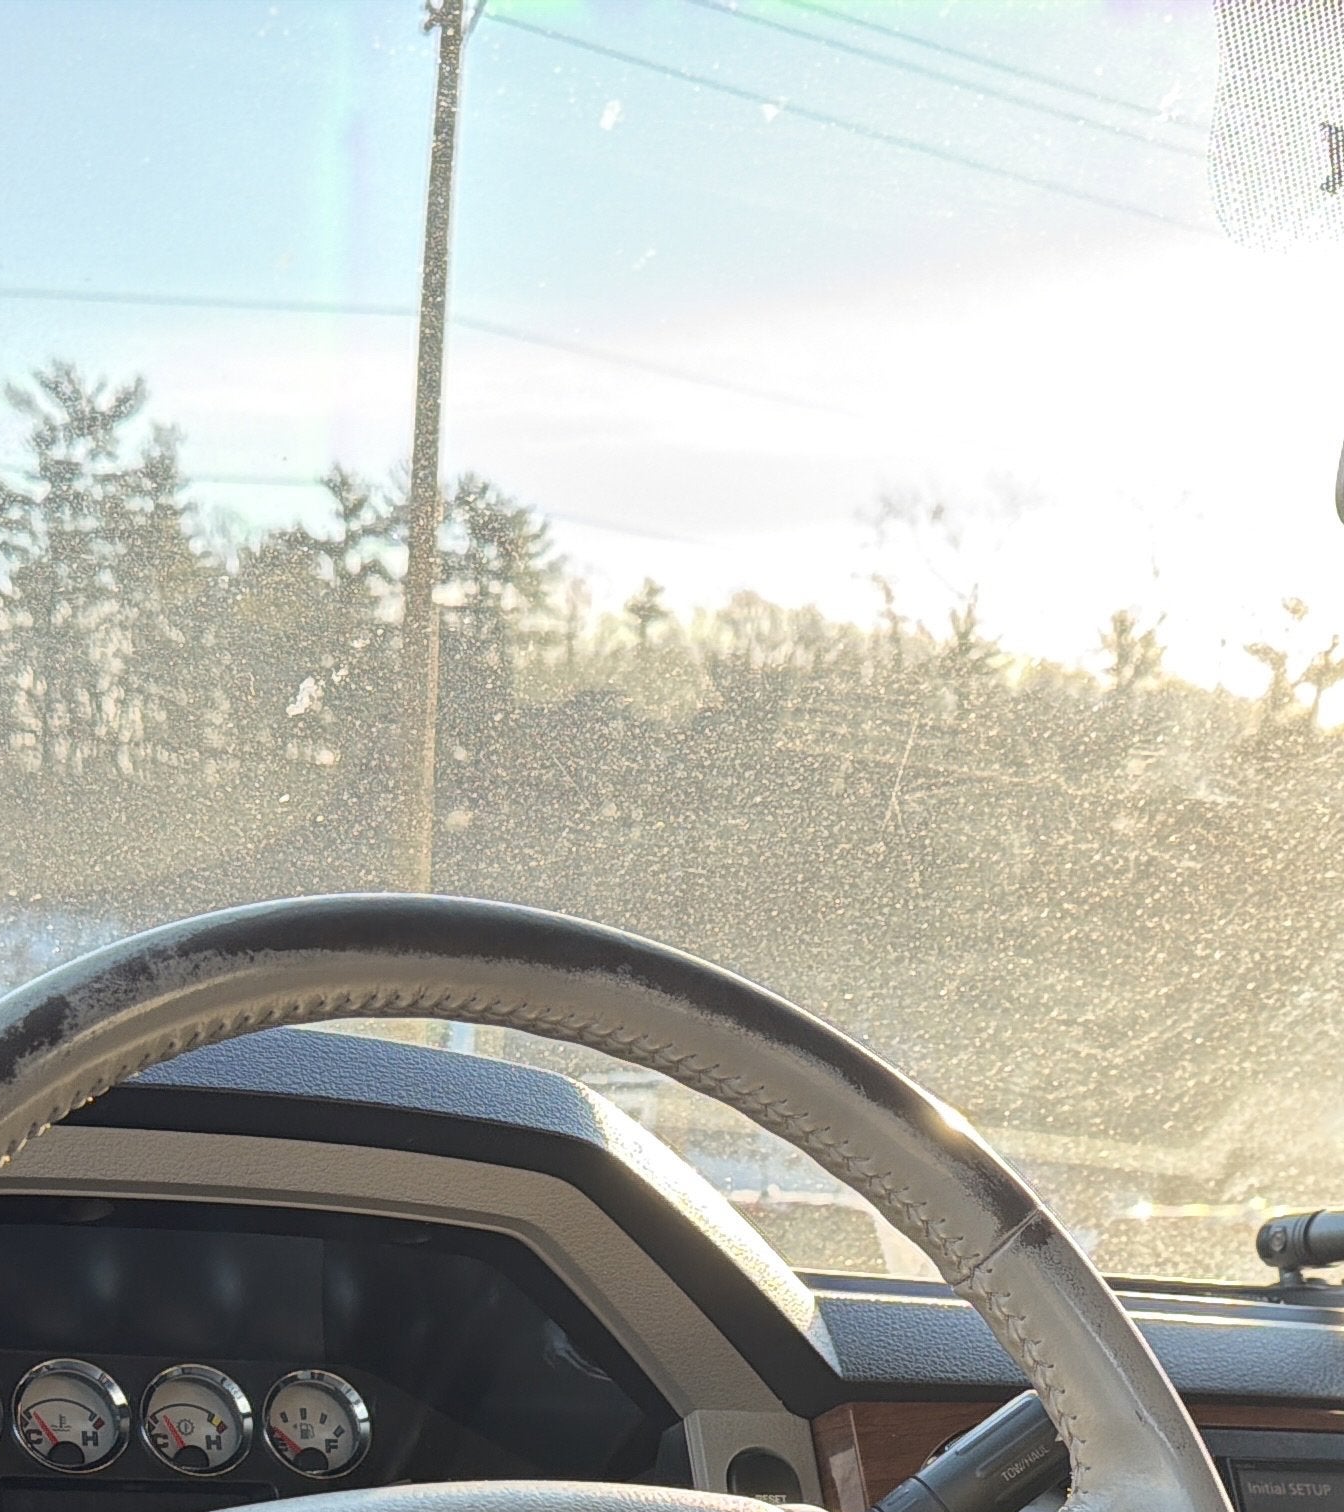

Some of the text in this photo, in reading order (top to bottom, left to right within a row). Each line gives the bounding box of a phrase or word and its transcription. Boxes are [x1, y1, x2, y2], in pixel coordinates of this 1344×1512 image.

[25, 1428, 43, 1445] C
[81, 1430, 99, 1447] H
[205, 1434, 222, 1451] H
[325, 1438, 338, 1454] F
[1000, 1444, 1050, 1481] TOW/HAUL
[1247, 1481, 1331, 1497] Initial SETUP
